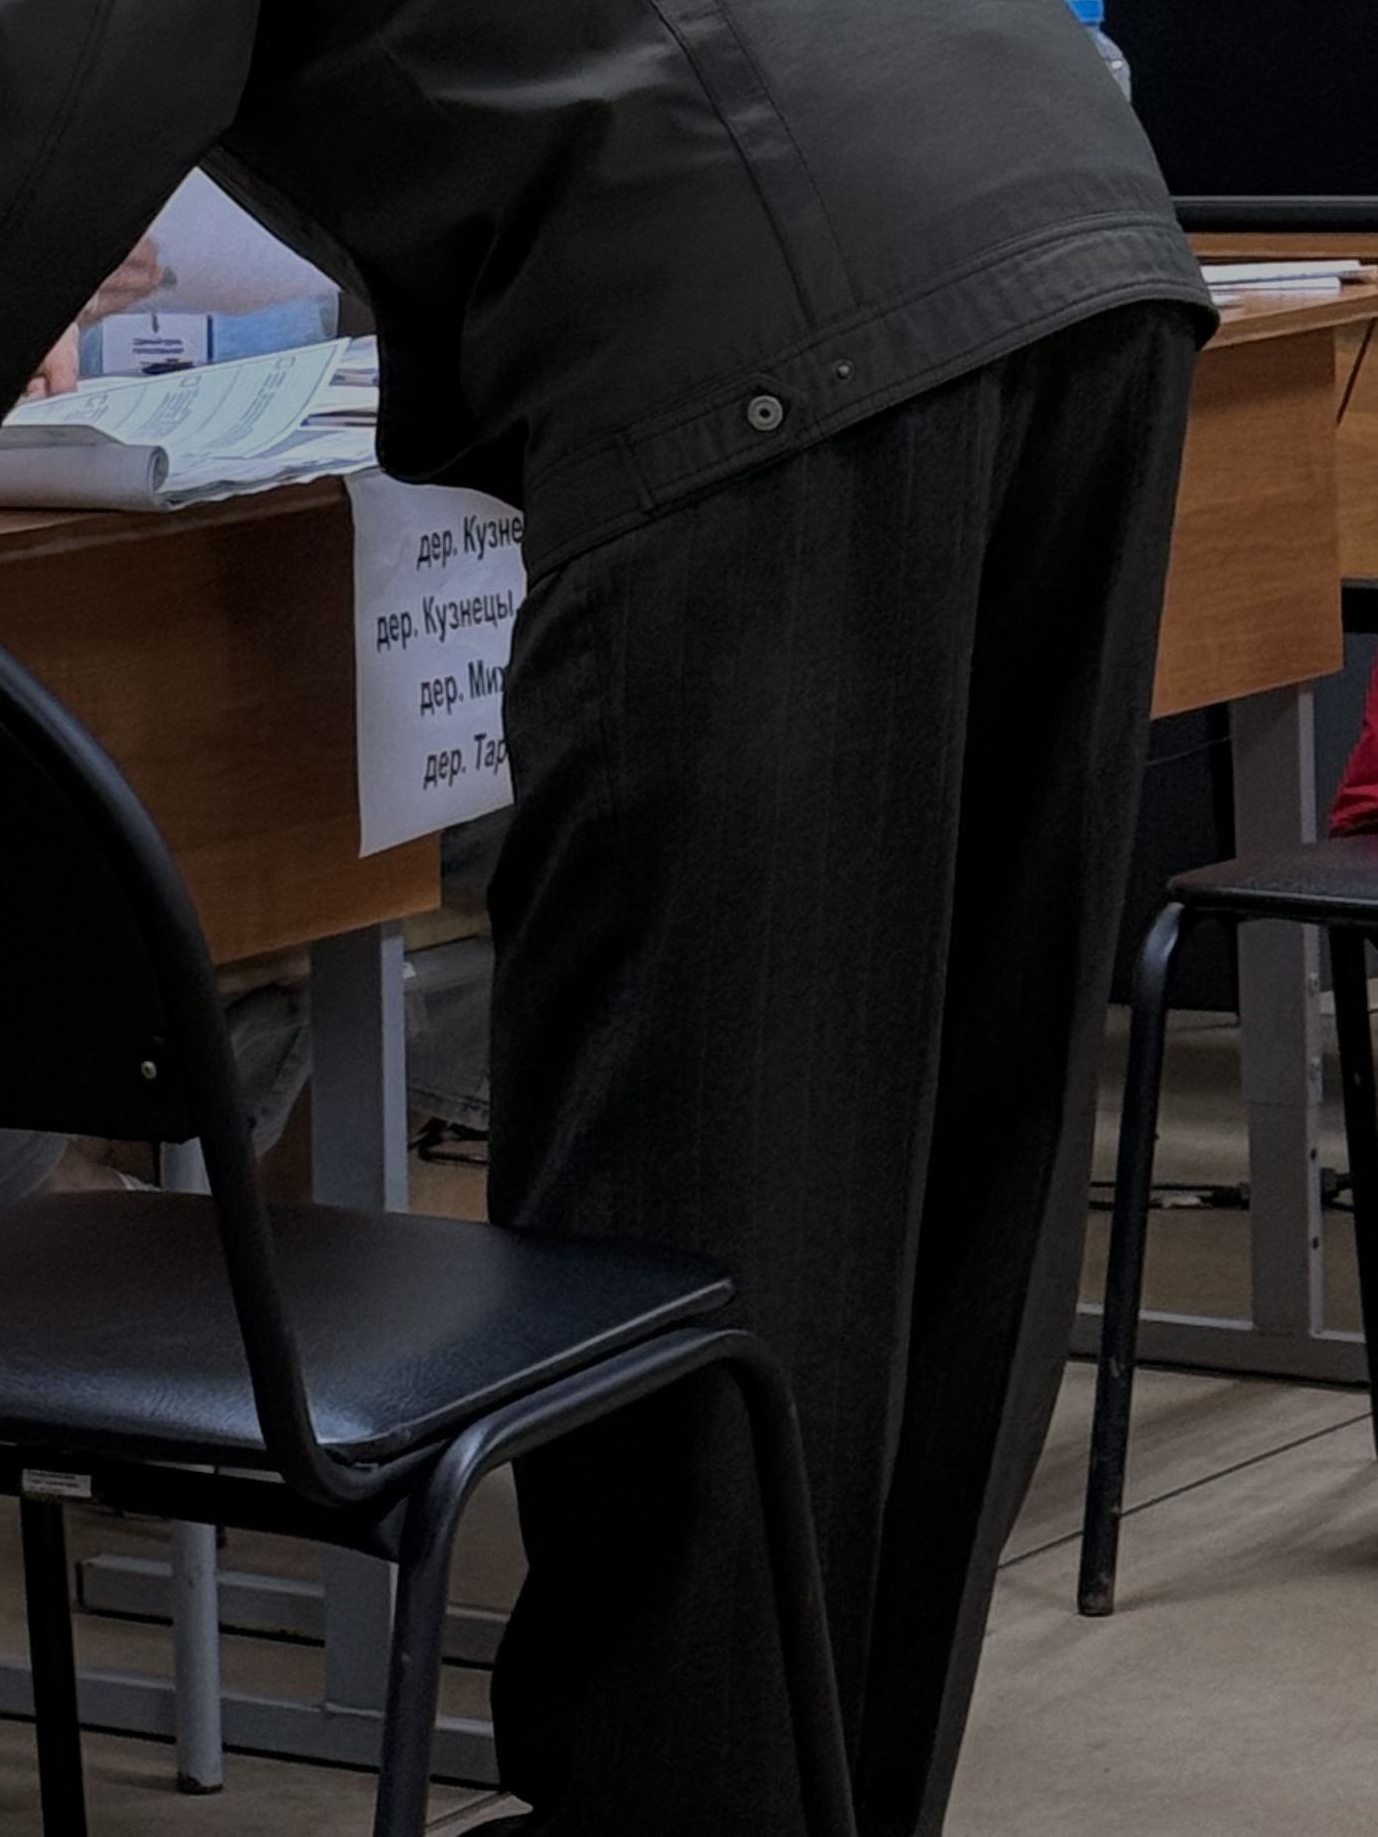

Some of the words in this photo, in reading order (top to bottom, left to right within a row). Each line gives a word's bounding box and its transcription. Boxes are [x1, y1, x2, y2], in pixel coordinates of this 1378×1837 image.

[416, 529, 458, 571] дер.
[463, 514, 524, 561] Кузне
[377, 611, 419, 653] дер.
[422, 589, 514, 643] Кузнецы
[420, 675, 464, 716] дер.
[422, 748, 466, 791] дер.
[473, 732, 507, 775] Тар
